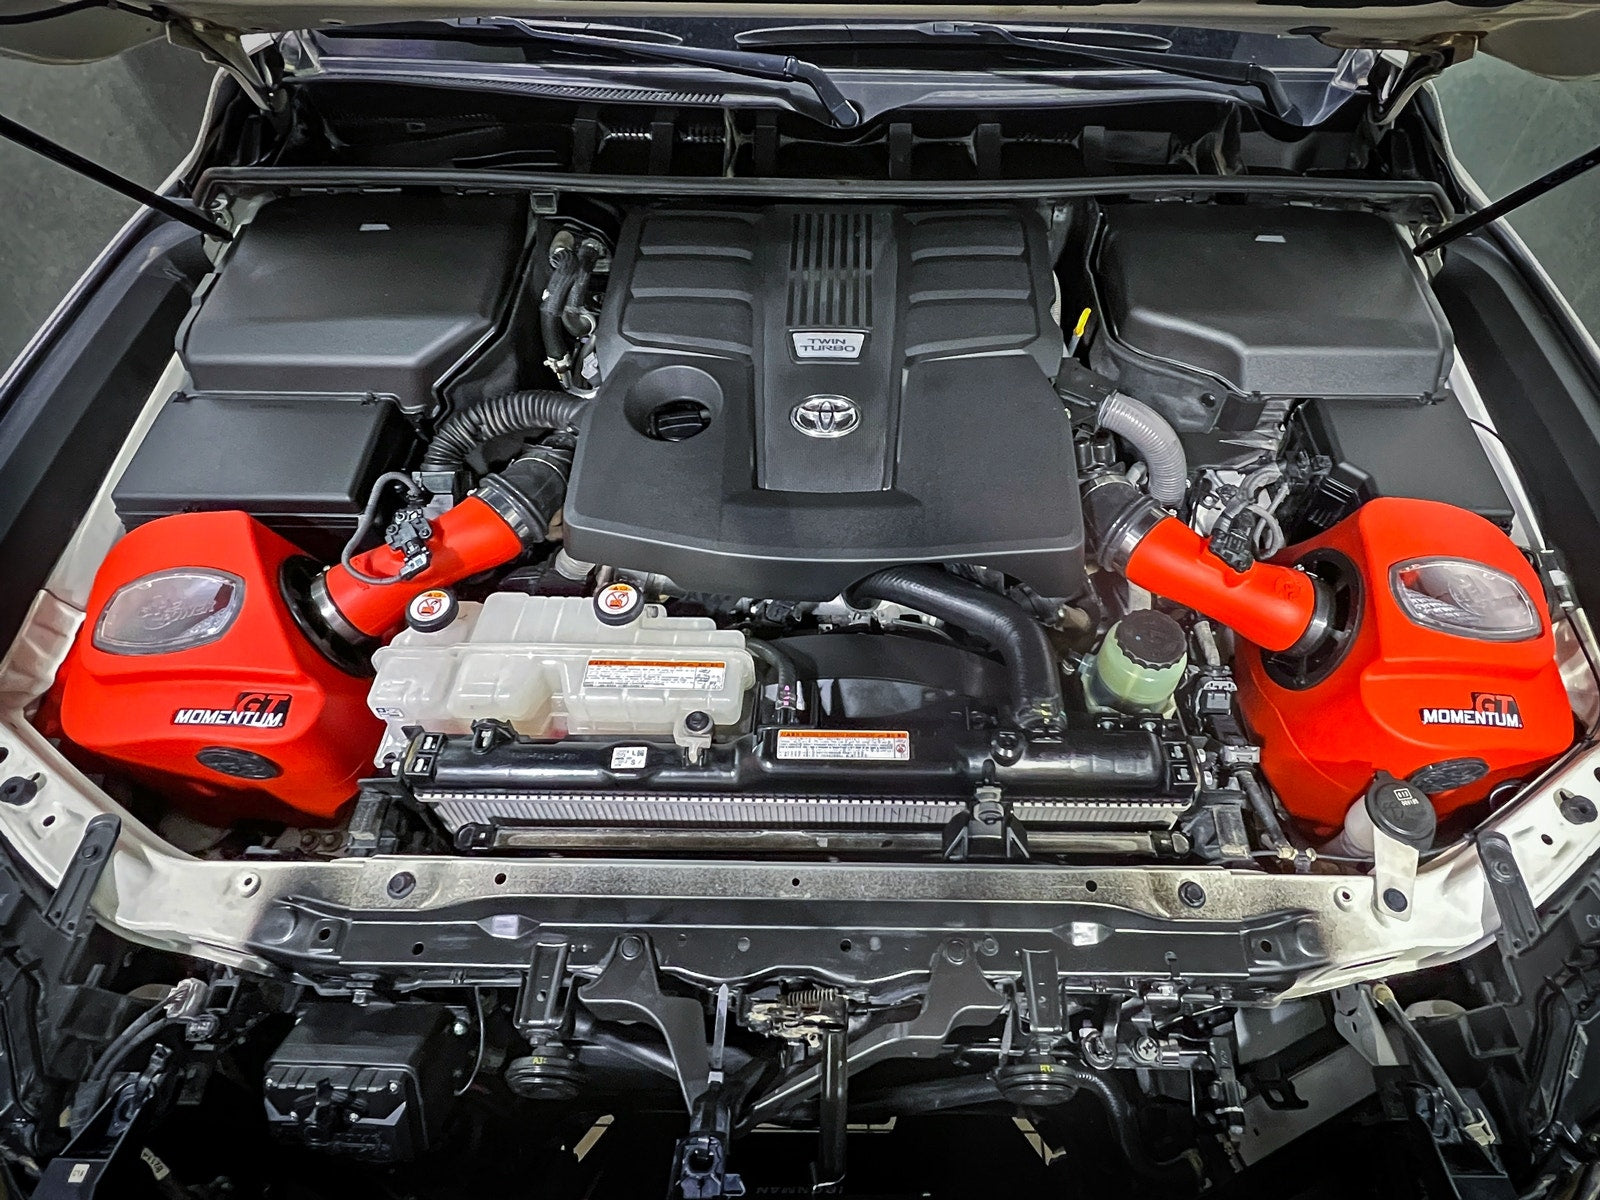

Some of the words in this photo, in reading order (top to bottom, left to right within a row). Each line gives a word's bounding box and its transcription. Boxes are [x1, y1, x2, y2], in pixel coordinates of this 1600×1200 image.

[236, 693, 289, 713] GT
[1475, 694, 1515, 714] GT
[174, 709, 283, 728] MOMENTUM
[1422, 708, 1520, 728] MOMENTUM
